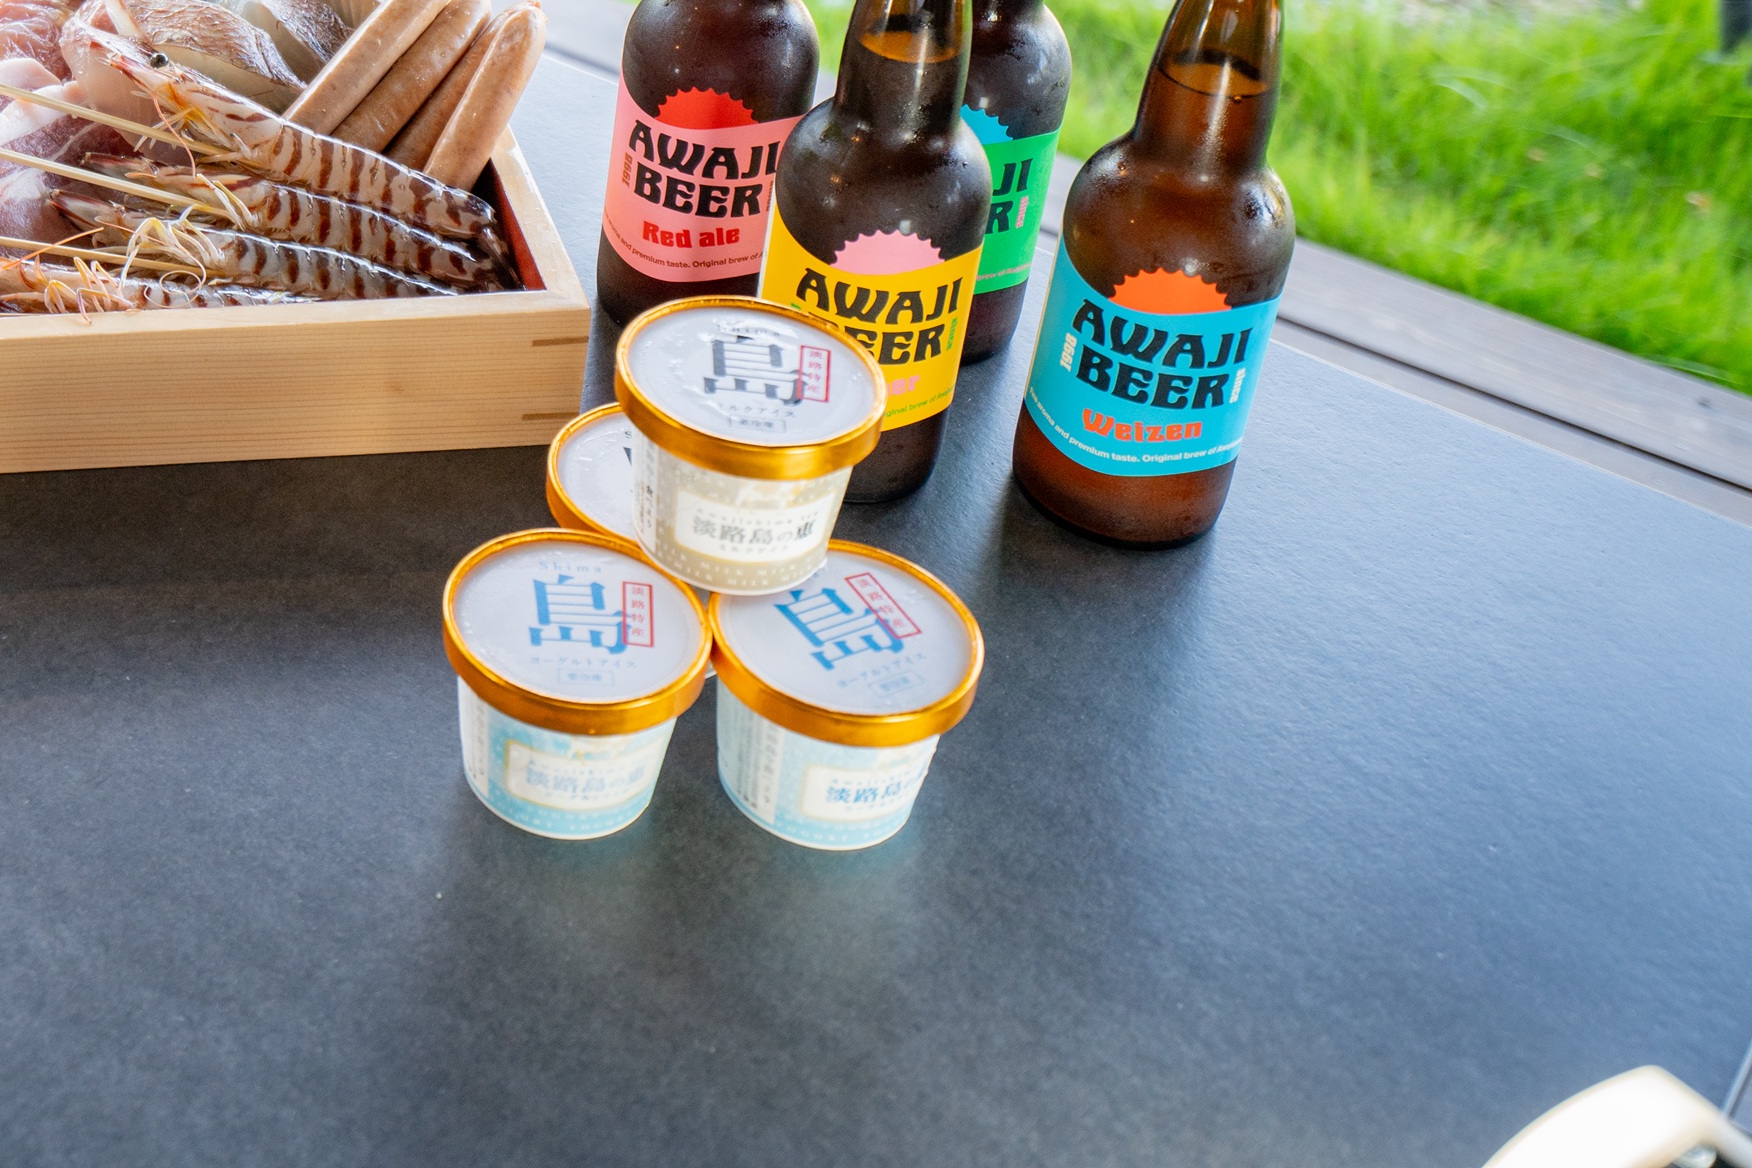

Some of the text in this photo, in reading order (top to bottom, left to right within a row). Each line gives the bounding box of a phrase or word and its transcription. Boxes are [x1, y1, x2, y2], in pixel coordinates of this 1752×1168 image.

[621, 151, 633, 189] 1998
[629, 119, 781, 180] AWAJI
[634, 161, 763, 219] BEER
[632, 247, 665, 266] premium
[666, 259, 691, 269] taste.
[692, 258, 727, 268] Original
[728, 255, 749, 264] brew
[642, 220, 740, 249] Red ale
[796, 267, 964, 325] AWAJI
[808, 312, 946, 365] EER
[1059, 332, 1078, 373] 1998
[1072, 298, 1253, 369] AWAJI
[1076, 344, 1230, 410] BEER
[1229, 367, 1247, 404] since
[1054, 425, 1070, 440] and
[1069, 437, 1110, 459] premium
[1111, 452, 1140, 463] taste.
[1142, 452, 1183, 464] Original
[1183, 449, 1206, 459] brew
[1082, 408, 1203, 443] Weizen
[539, 561, 603, 574] Shima
[529, 574, 632, 655] 島
[773, 587, 905, 671] 島
